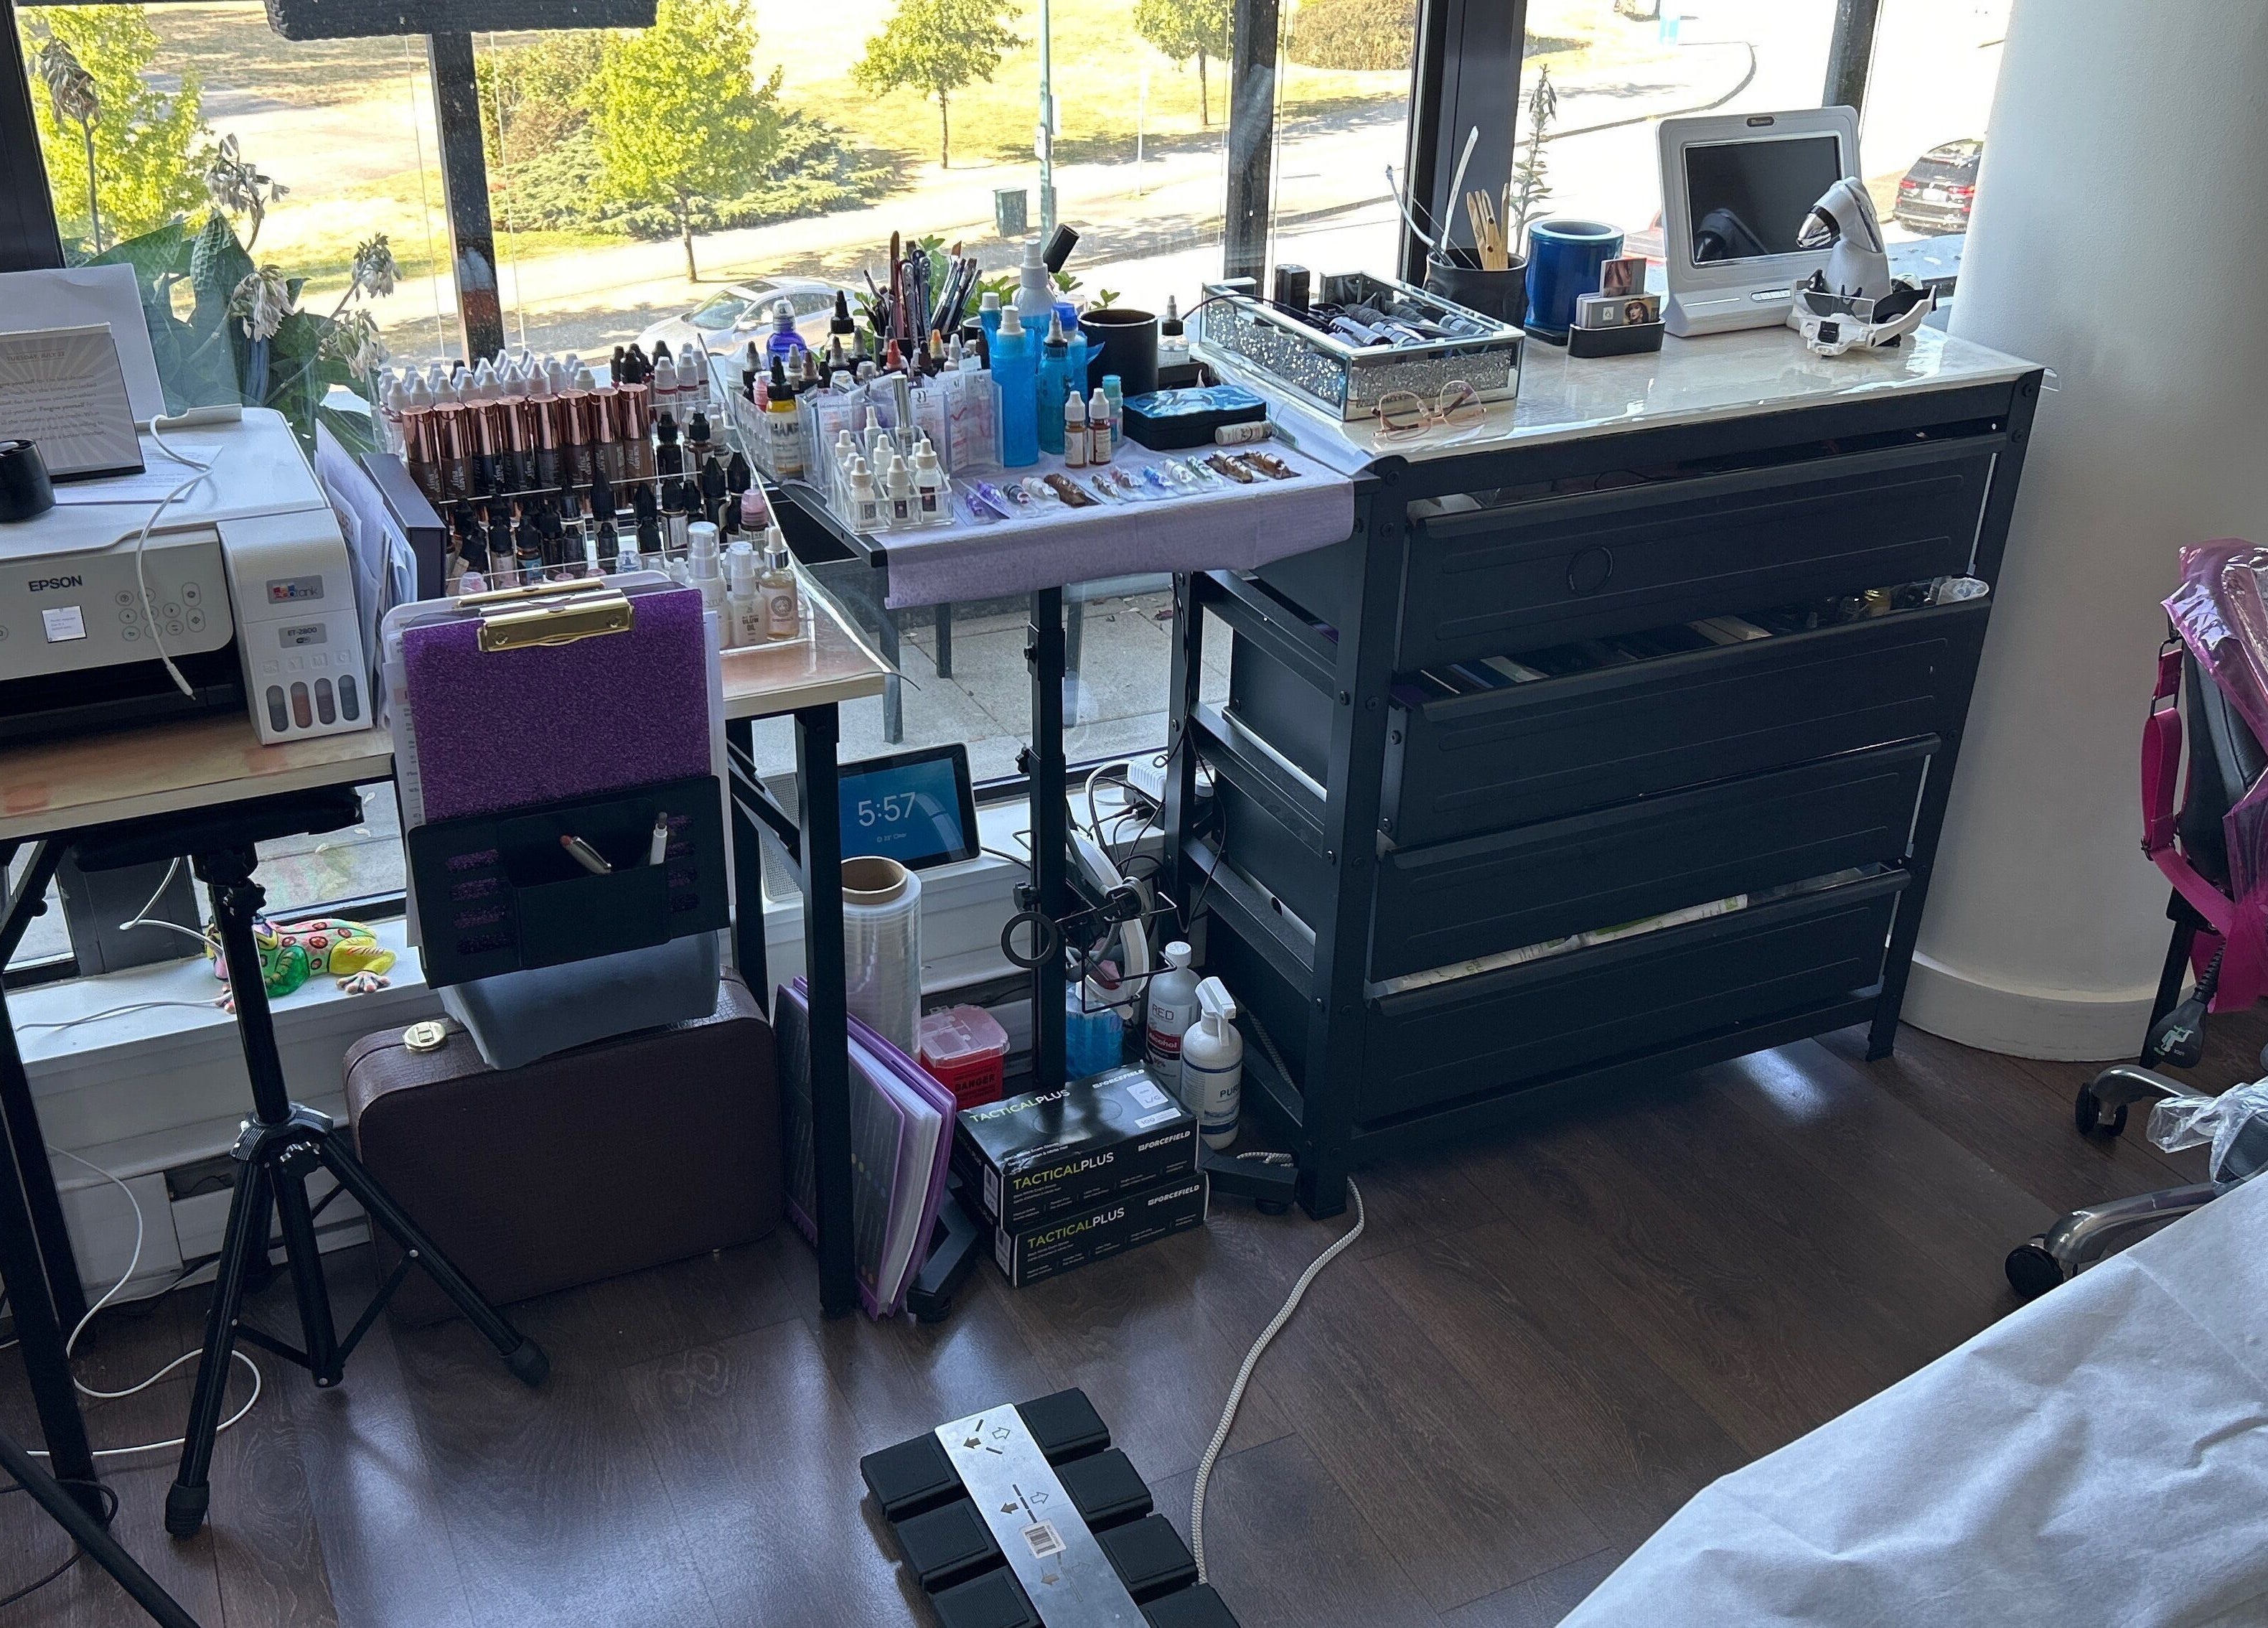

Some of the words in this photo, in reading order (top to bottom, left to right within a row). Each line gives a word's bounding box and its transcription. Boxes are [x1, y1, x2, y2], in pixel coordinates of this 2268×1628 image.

[29, 575, 83, 591] EPSON
[858, 791, 917, 827] 5:57
[1152, 1004, 1174, 1021] RED
[955, 1074, 995, 1092] DANGER
[1099, 1068, 1145, 1087] FORCEFIELD
[970, 1089, 1071, 1123] TACTICALPLUS
[1145, 1131, 1191, 1149] FORCEFIELD
[1013, 1152, 1114, 1190] TACTICALPLUS
[1154, 1185, 1200, 1204] FORCEFIELD
[1028, 1207, 1125, 1249] TACTICALPLUS
